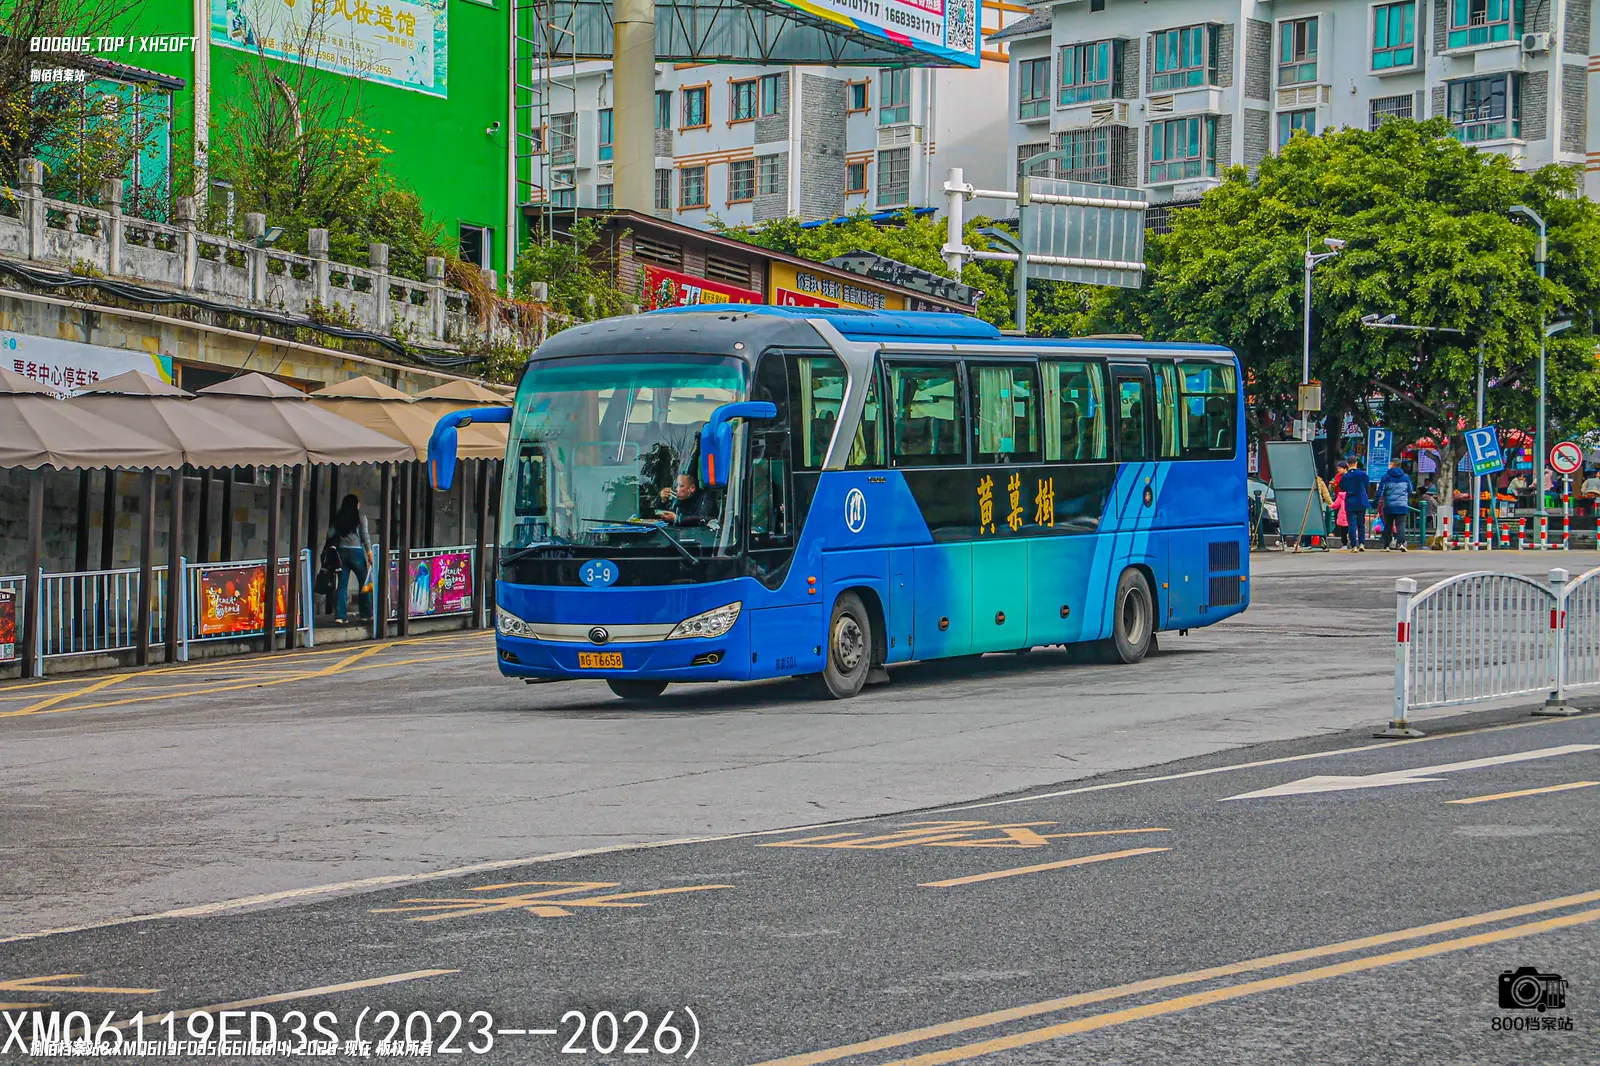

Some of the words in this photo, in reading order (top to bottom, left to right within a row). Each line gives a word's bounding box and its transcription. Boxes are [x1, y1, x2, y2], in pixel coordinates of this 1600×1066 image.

[884, 6, 941, 37] 16683931717
[1374, 430, 1385, 447] P
[1469, 431, 1492, 461] P
[586, 568, 611, 582] 3-9
